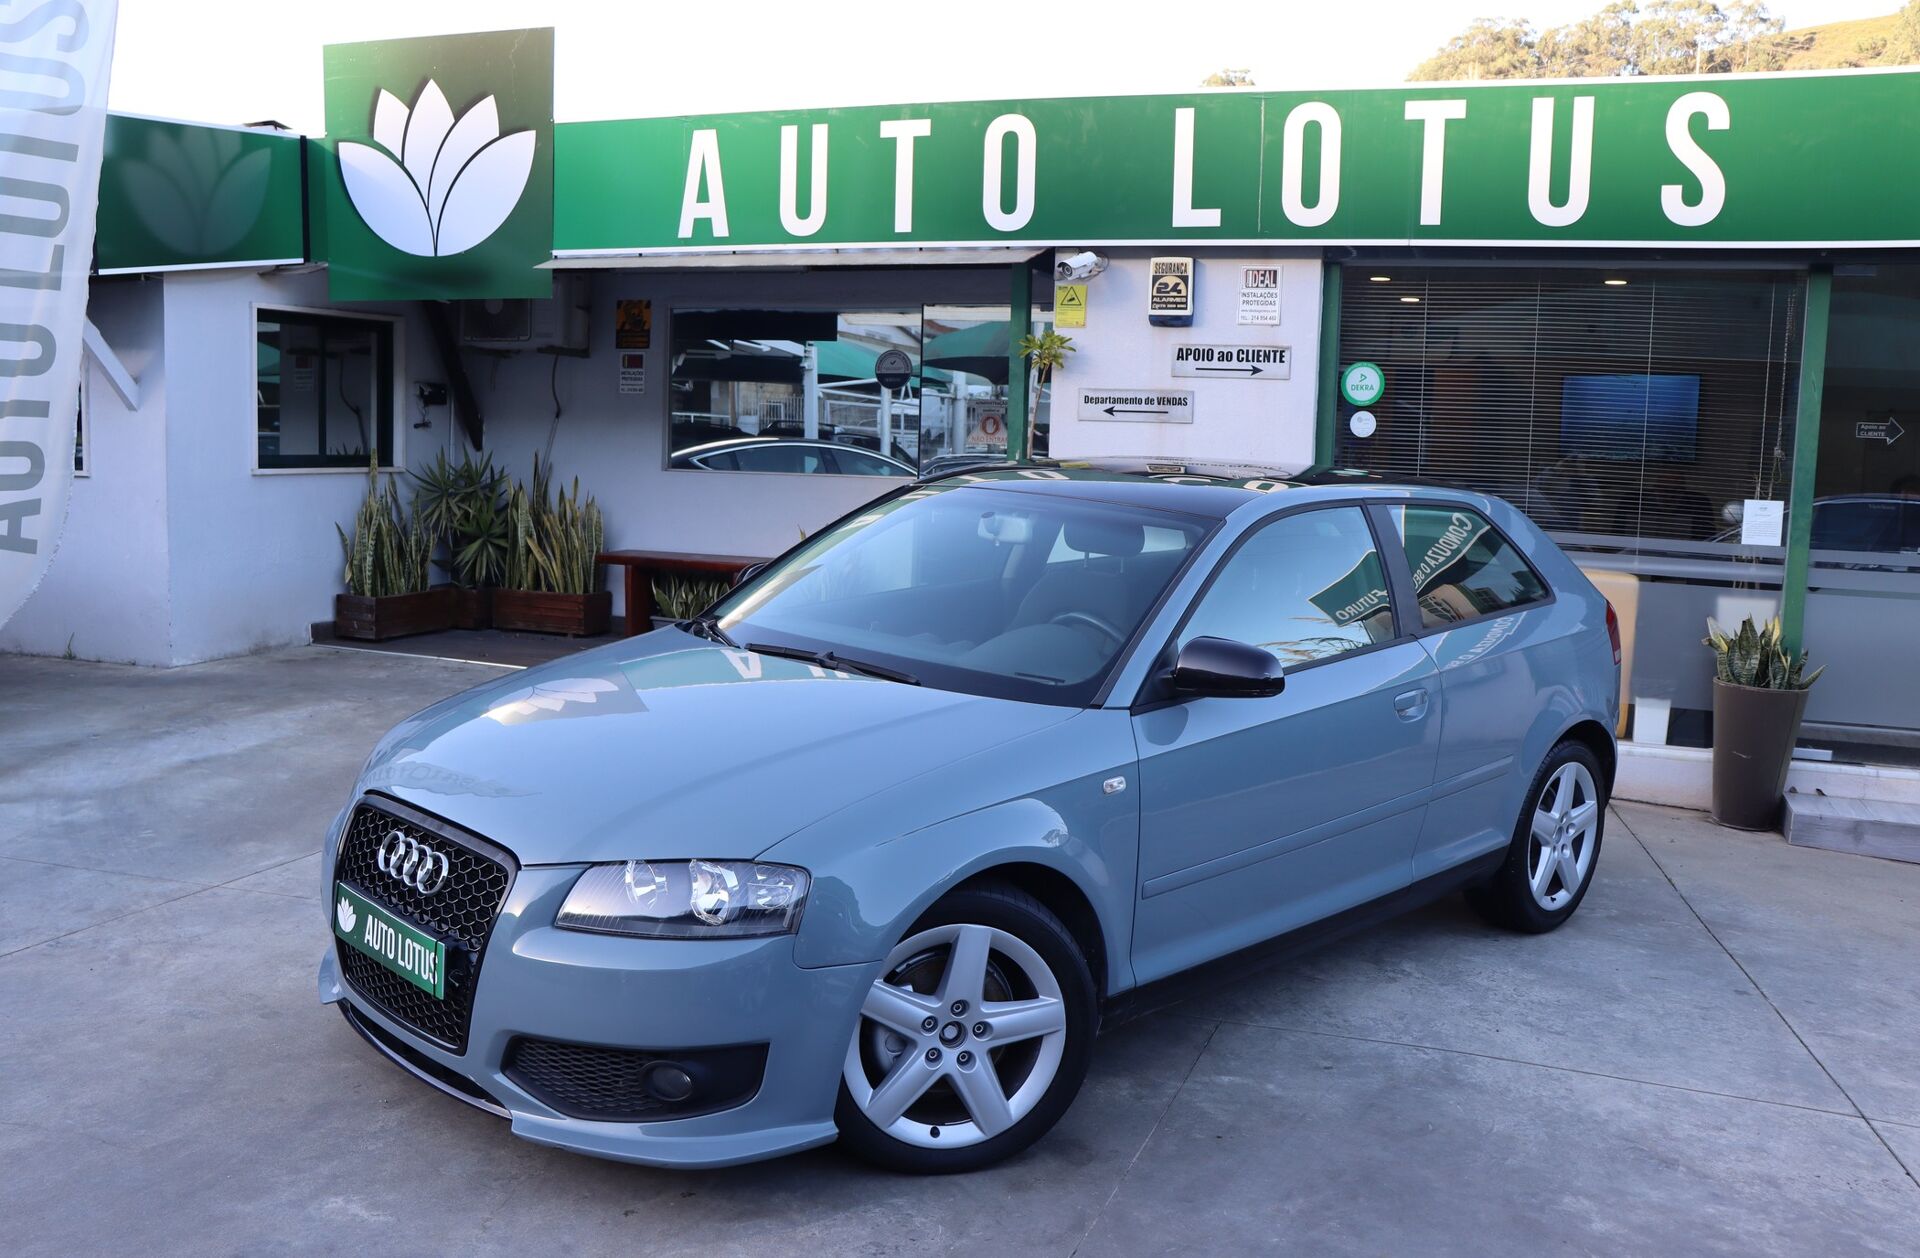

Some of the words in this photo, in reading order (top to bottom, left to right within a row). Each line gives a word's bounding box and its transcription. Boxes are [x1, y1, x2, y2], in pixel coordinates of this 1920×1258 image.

[677, 113, 1037, 238] AUTO
[1172, 91, 1731, 228] LOTUS
[1246, 270, 1277, 288] IDEAL
[1156, 282, 1182, 294] 24
[1241, 291, 1278, 299] INSTALAÇÕES
[1176, 348, 1214, 362] APOIO
[1217, 351, 1233, 362] ao
[1236, 349, 1286, 363] CLIENTE
[1083, 395, 1143, 406] Departamento
[1144, 396, 1155, 406] de
[1156, 396, 1189, 406] VENDAS
[364, 913, 396, 960] AUTO
[397, 933, 439, 985] LOTUS
